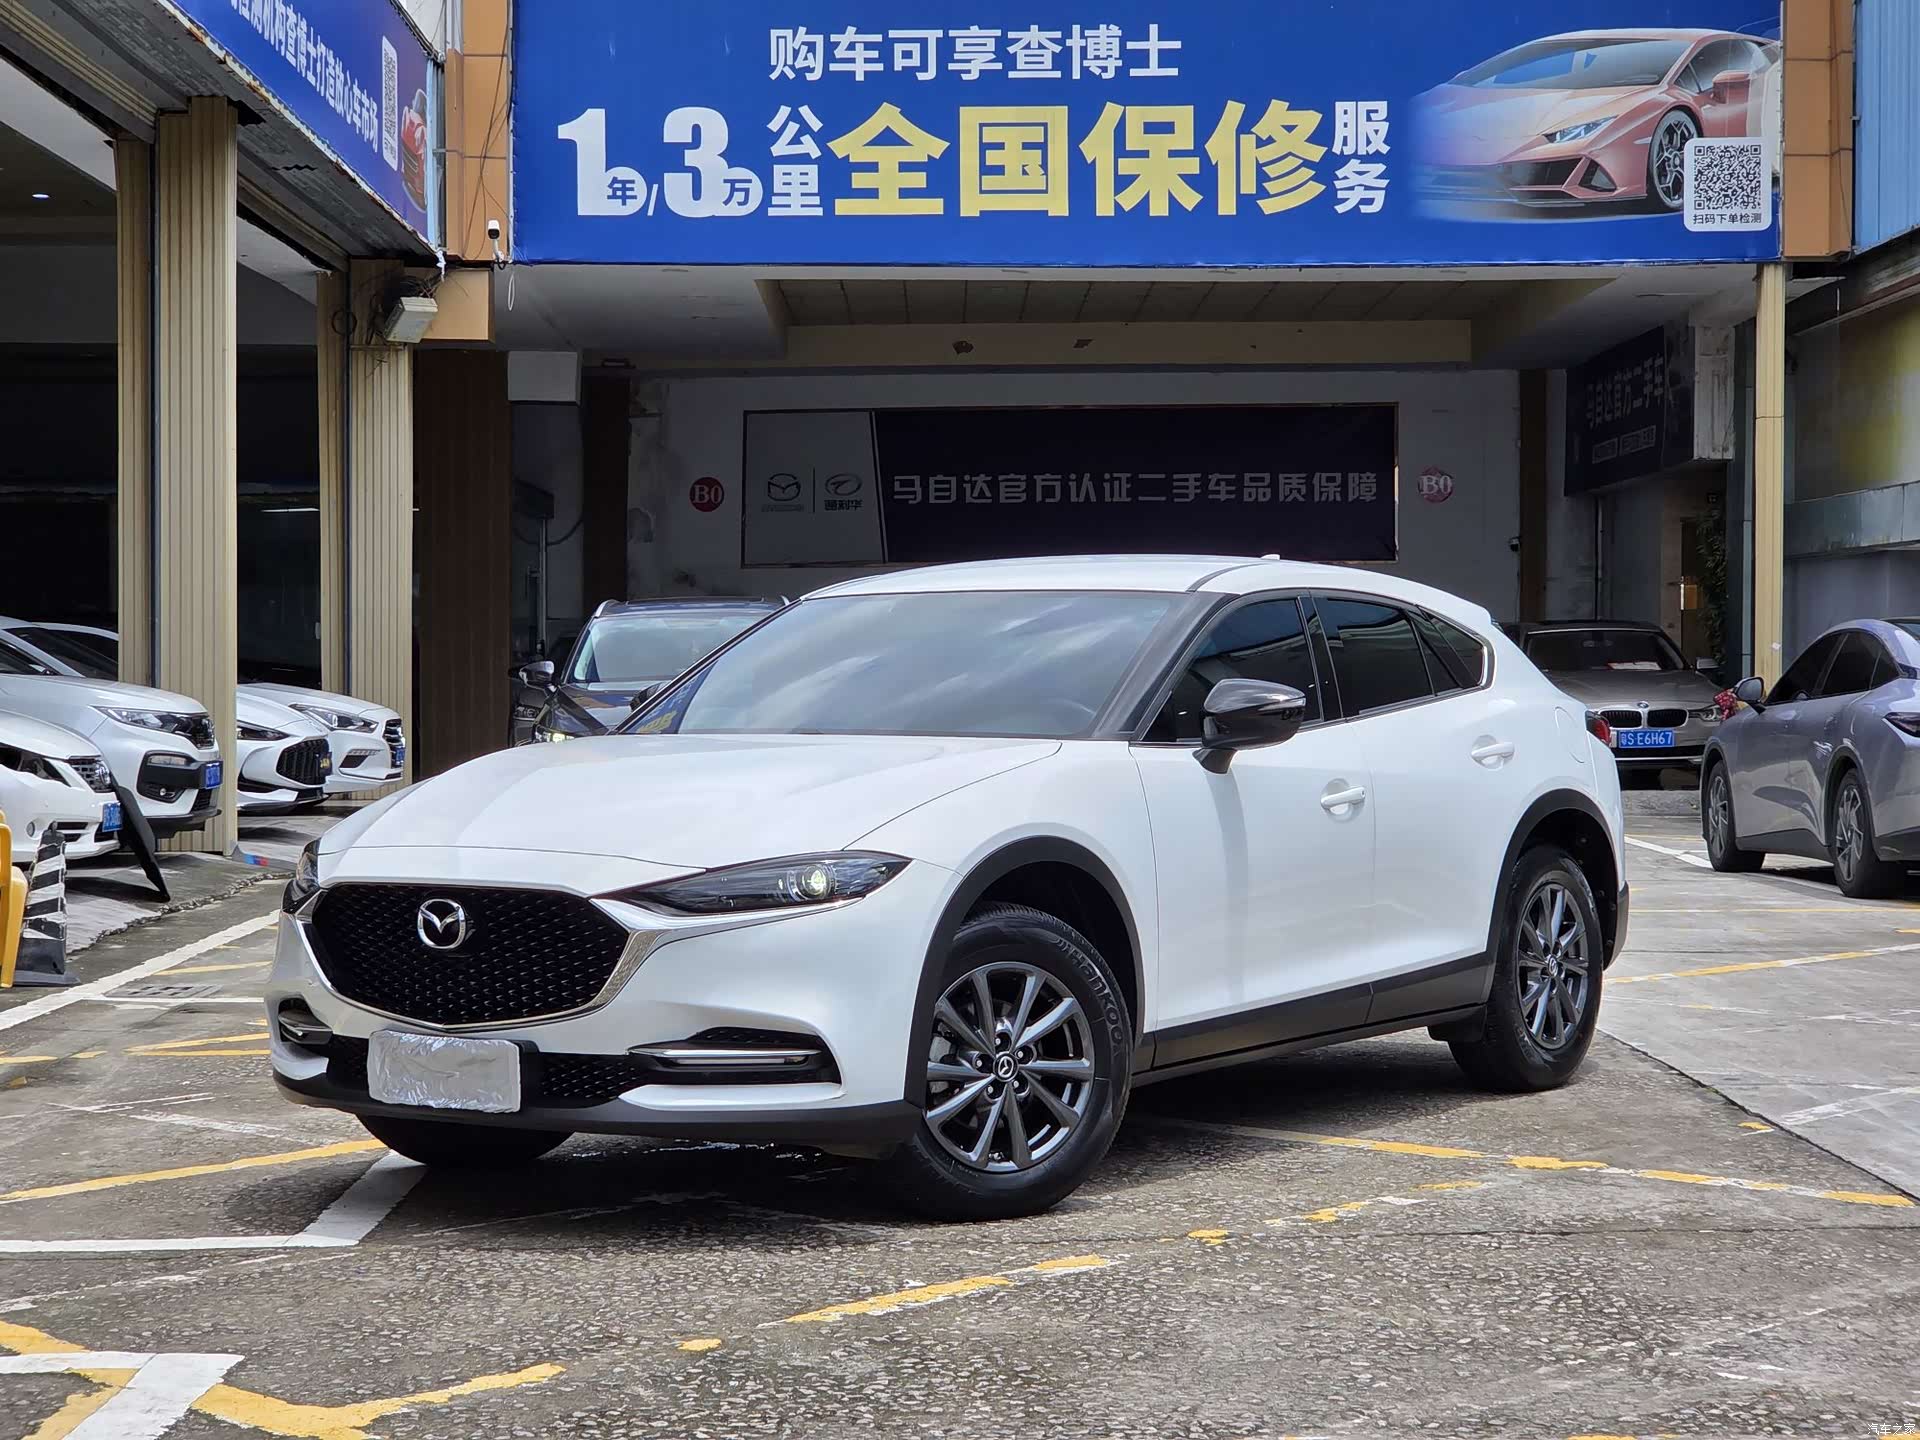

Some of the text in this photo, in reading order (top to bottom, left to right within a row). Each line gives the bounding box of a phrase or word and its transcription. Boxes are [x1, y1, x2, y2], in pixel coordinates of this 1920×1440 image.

[769, 23, 1182, 82] 购车可享查博士
[1692, 212, 1762, 225] 扫码下单检测
[893, 471, 1379, 505] 马自达官方认证二手车品质保障
